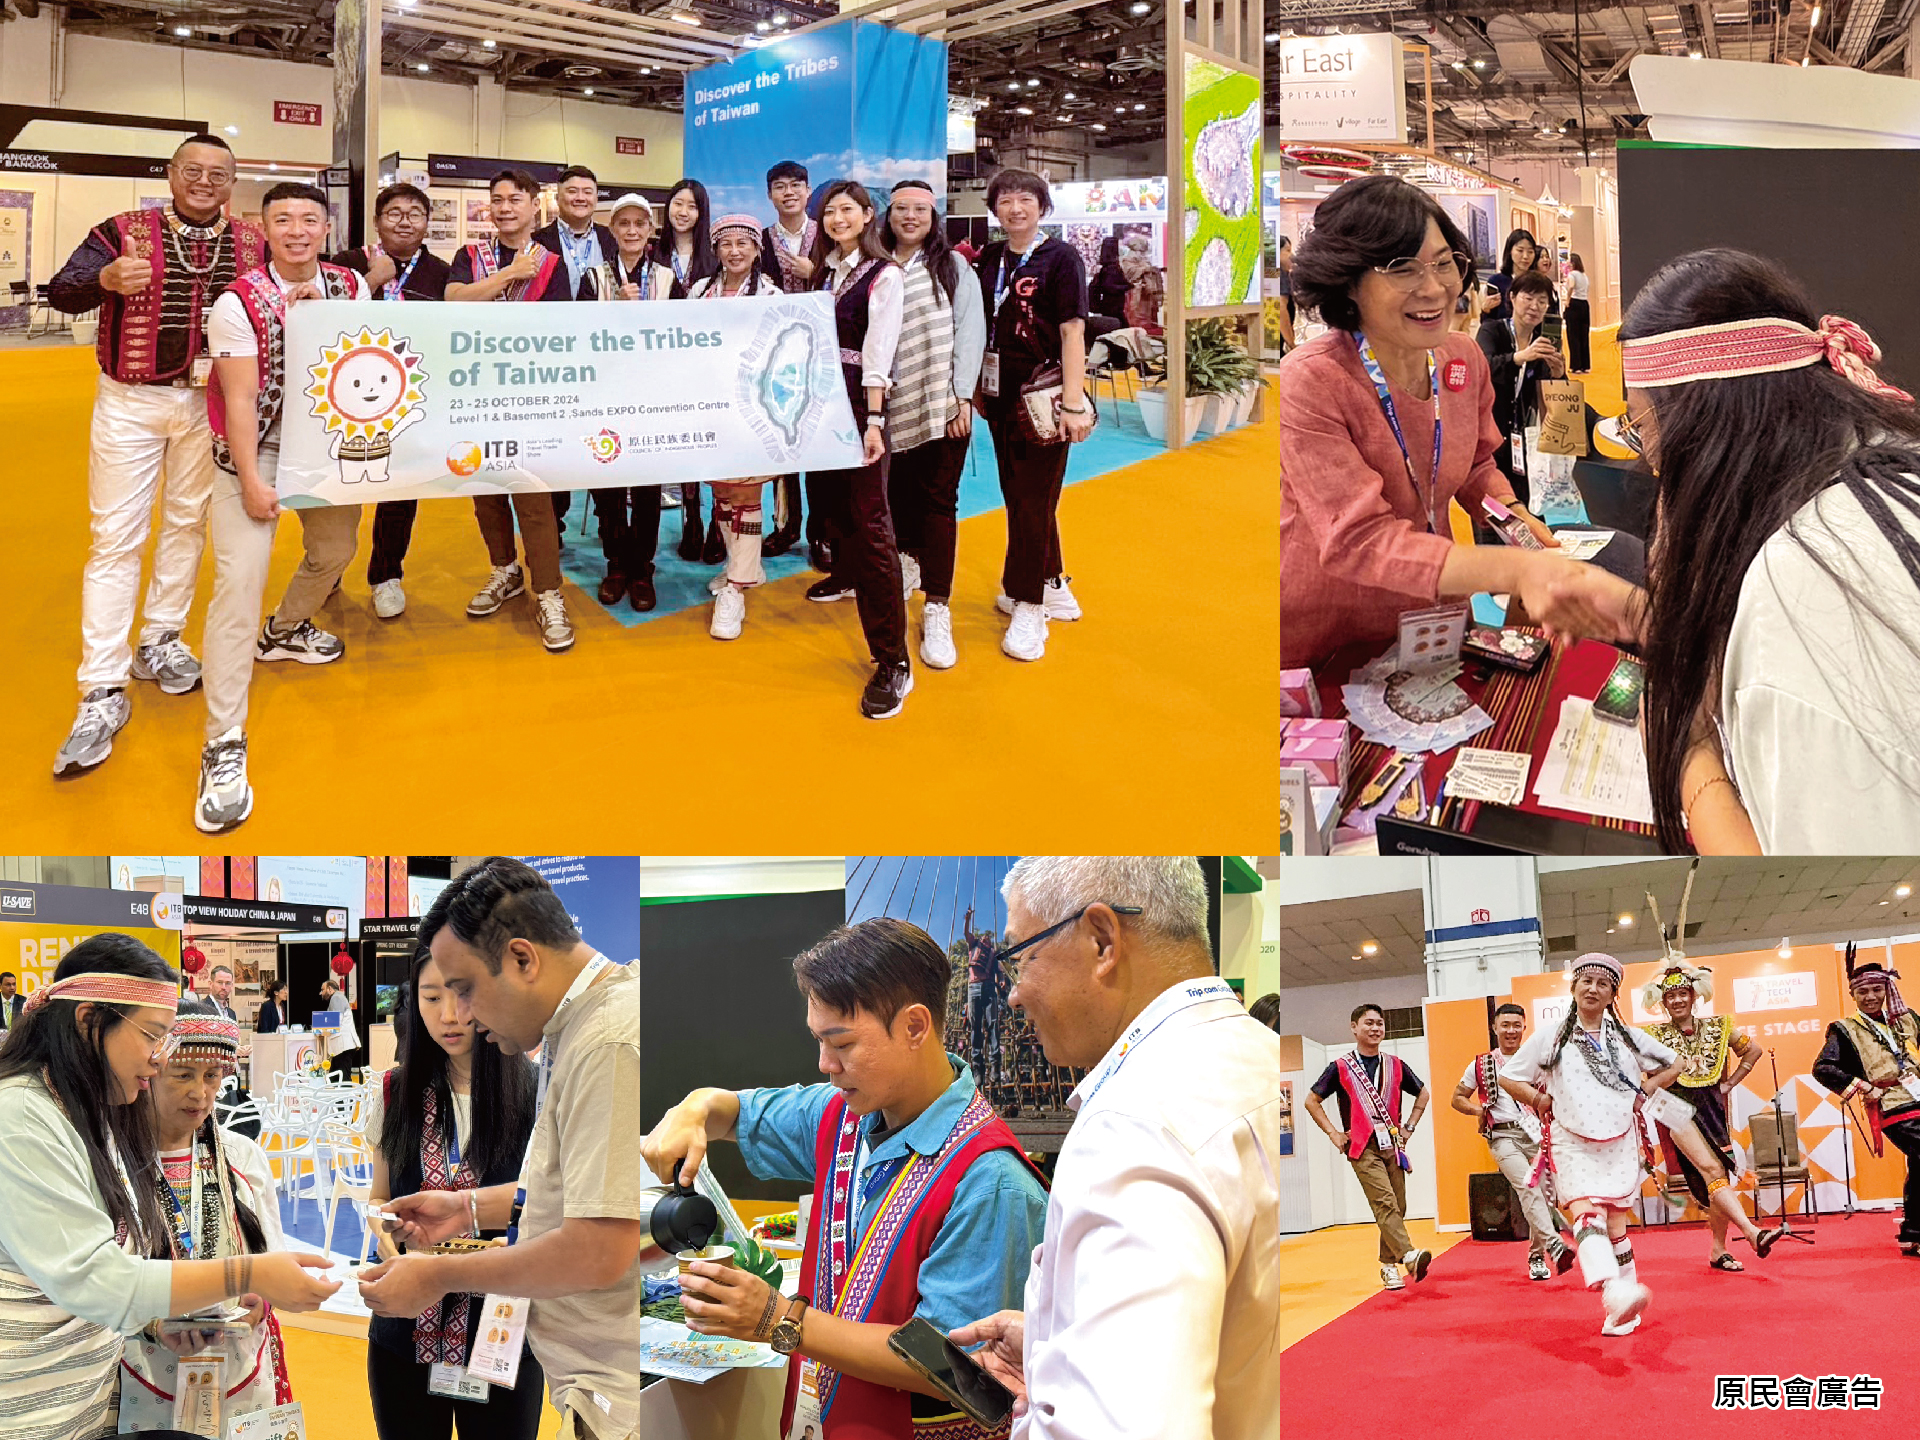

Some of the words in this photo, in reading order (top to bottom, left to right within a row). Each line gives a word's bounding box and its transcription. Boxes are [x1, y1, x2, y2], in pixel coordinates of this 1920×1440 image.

[1303, 48, 1354, 73] East
[695, 79, 751, 105] Discover
[755, 71, 780, 89] the
[785, 56, 838, 81] Tribes
[695, 110, 707, 126] of
[711, 102, 760, 122] Taiwan
[5, 161, 58, 170] BANGKOK
[449, 330, 577, 354] Discover
[590, 329, 635, 352] the
[639, 327, 723, 350] Tribes
[448, 362, 481, 387] of
[493, 360, 597, 386] Taiwan
[450, 399, 464, 409] 23
[474, 398, 489, 409] 25
[491, 396, 550, 408] OCTOBER
[553, 395, 580, 406] 2024
[1567, 404, 1580, 413] JU
[449, 414, 480, 424] Level
[484, 413, 489, 422] 1
[503, 411, 557, 422] Basement
[607, 405, 636, 416] EXPO
[638, 403, 696, 415] Convention
[698, 401, 730, 411] Centre
[629, 431, 717, 447] 原住民族委員會
[485, 440, 519, 458] ITB
[485, 460, 518, 471] ASIA
[2, 895, 33, 908] U-SAVE
[130, 903, 149, 915] E48
[170, 904, 182, 914] ITB
[183, 905, 198, 915] TOP
[198, 907, 217, 916] VIEW
[218, 908, 248, 918] HOLIDAY
[248, 909, 270, 920] CHINA
[270, 910, 276, 919] &
[276, 911, 297, 922] JAPAN
[363, 925, 381, 933] STAR
[382, 924, 409, 933] TRAVEL
[1766, 978, 1804, 988] TRAVEL
[1186, 985, 1219, 998] Trip.com
[1767, 987, 1792, 997] TECH
[1767, 997, 1790, 1006] ASIA
[1763, 1019, 1821, 1036] STAGE
